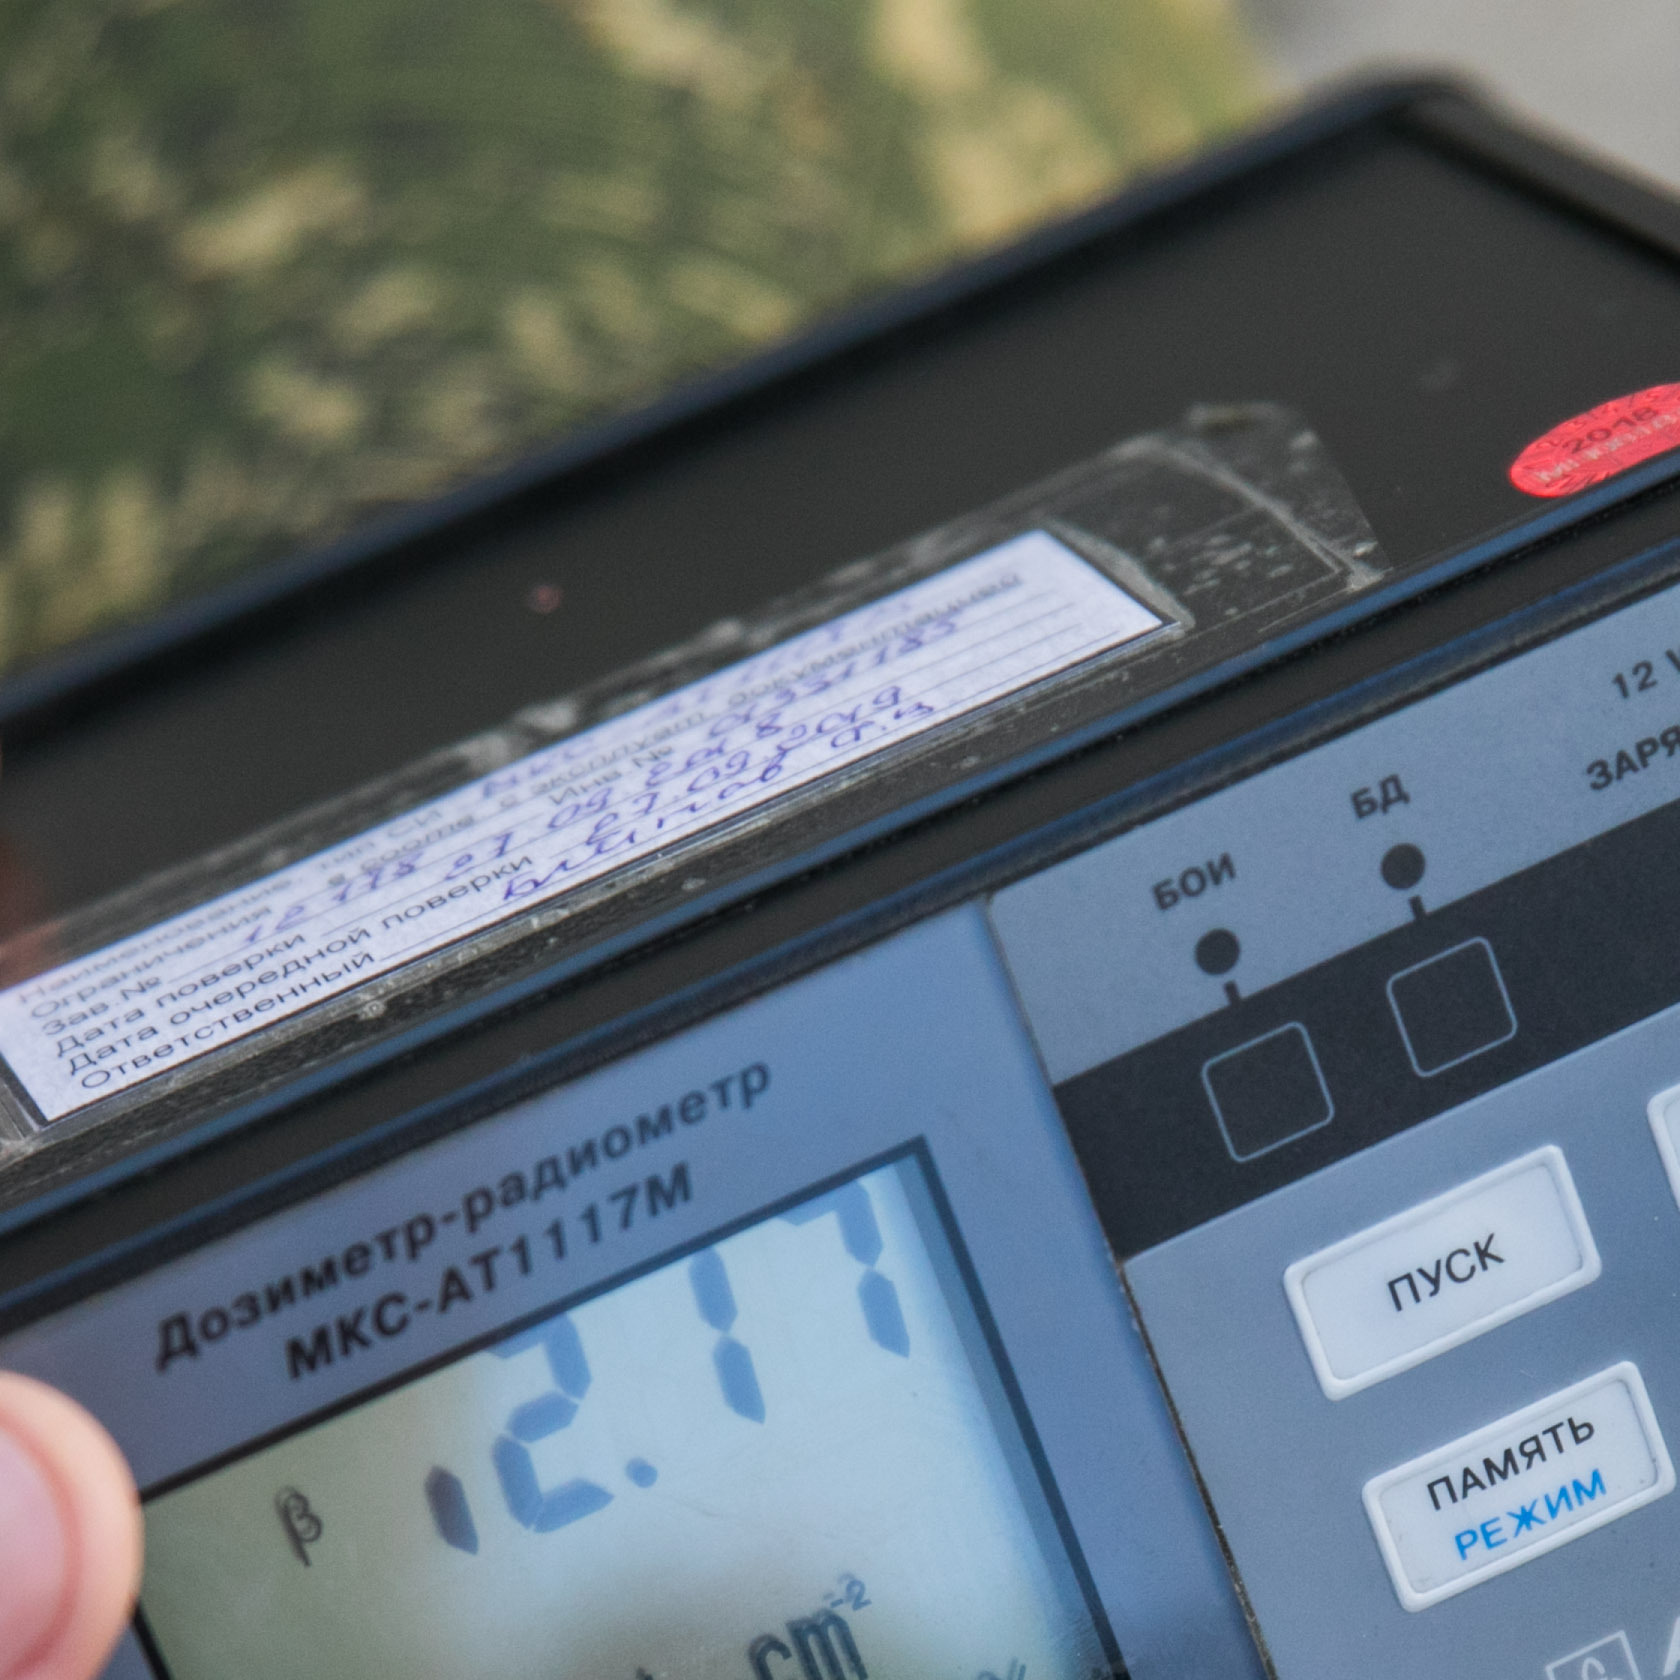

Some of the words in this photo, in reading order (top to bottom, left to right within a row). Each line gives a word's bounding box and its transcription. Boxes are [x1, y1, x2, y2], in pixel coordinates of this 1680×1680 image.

[1610, 660, 1657, 700] 12
[387, 811, 440, 837] СИ
[1350, 774, 1412, 821] БД
[1152, 851, 1238, 912] БОИ
[31, 907, 272, 1019] Ограничения
[54, 1008, 144, 1054] Дата
[156, 936, 305, 1007] поверки
[65, 1025, 157, 1072] Дата
[168, 928, 371, 1024] очередной
[382, 858, 533, 929] поверки
[80, 951, 374, 1088] Ответственный
[156, 1060, 773, 1374] Дозиметр-радиометр
[1386, 1232, 1506, 1313] ПУСК
[1426, 1413, 1597, 1514] ПАМЯТЬ
[1453, 1468, 1609, 1562] РЕЖИМ
